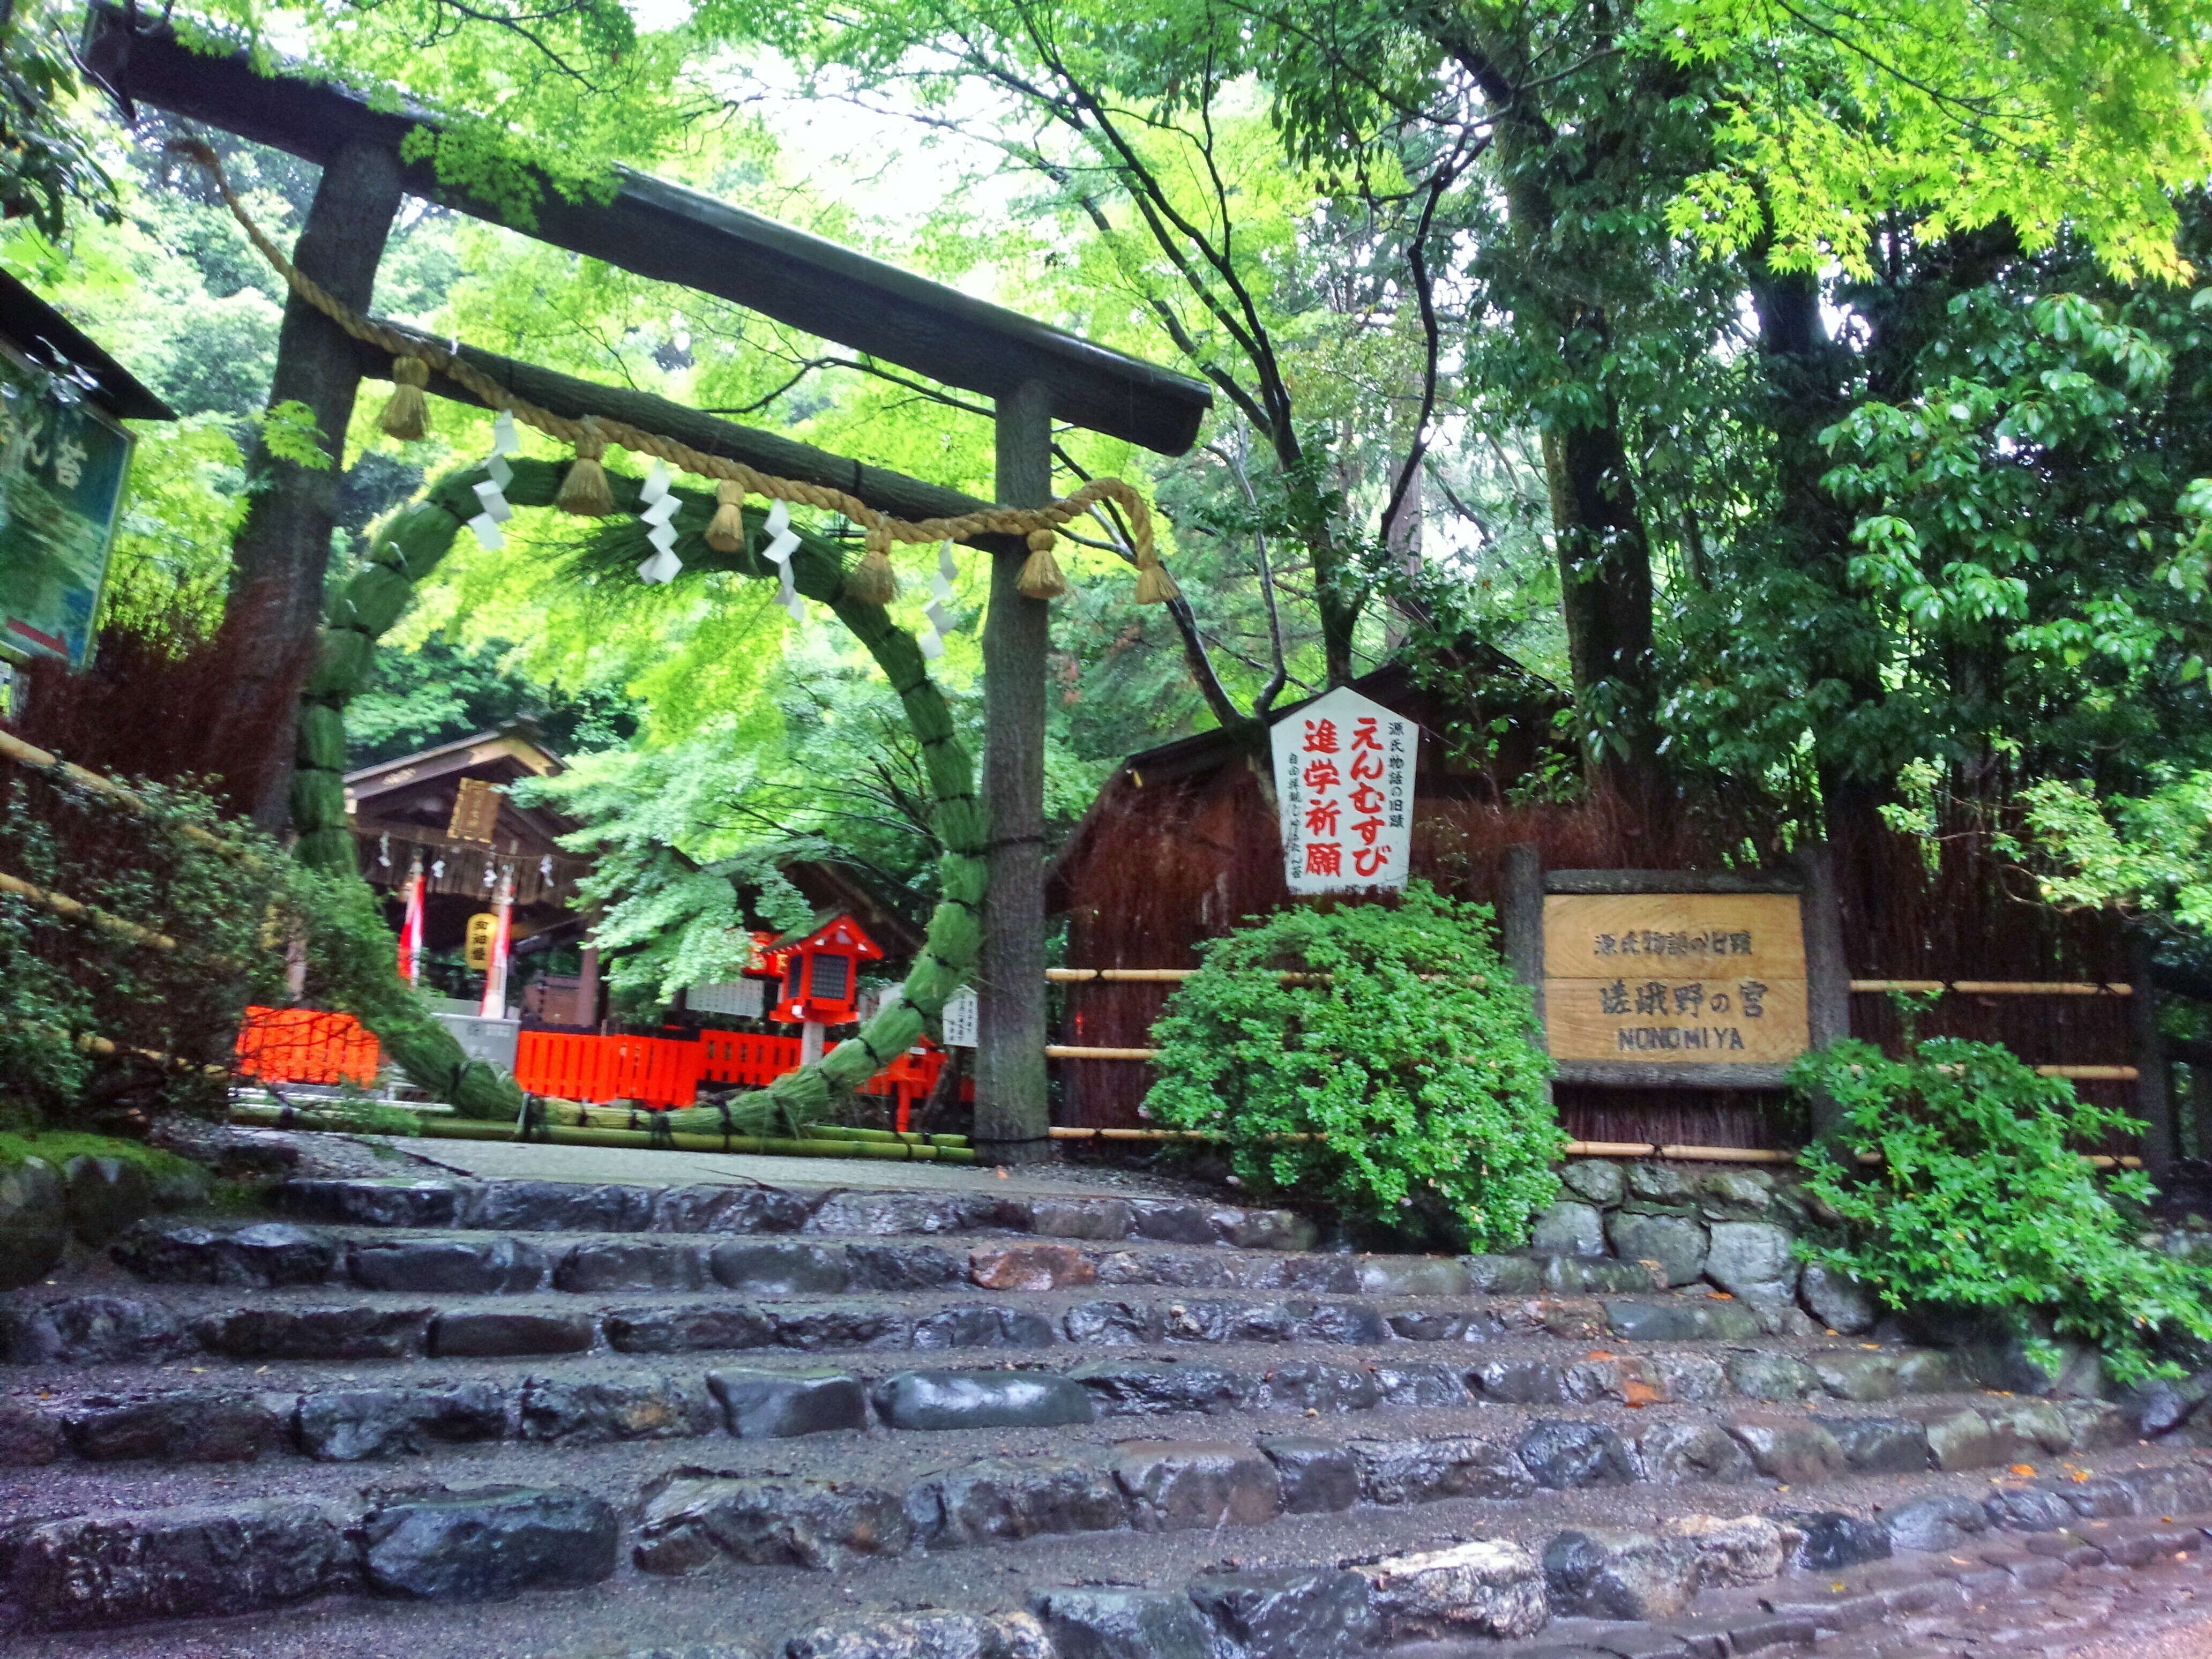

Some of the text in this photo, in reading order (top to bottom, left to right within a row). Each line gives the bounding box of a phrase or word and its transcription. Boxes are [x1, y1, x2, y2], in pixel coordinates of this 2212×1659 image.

[1303, 718, 1341, 877] 進学祈願
[1348, 717, 1392, 877] えんむすび
[1600, 978, 1769, 1018] 嵯峨野の宮
[1619, 1027, 1745, 1050] NONOMIYA
